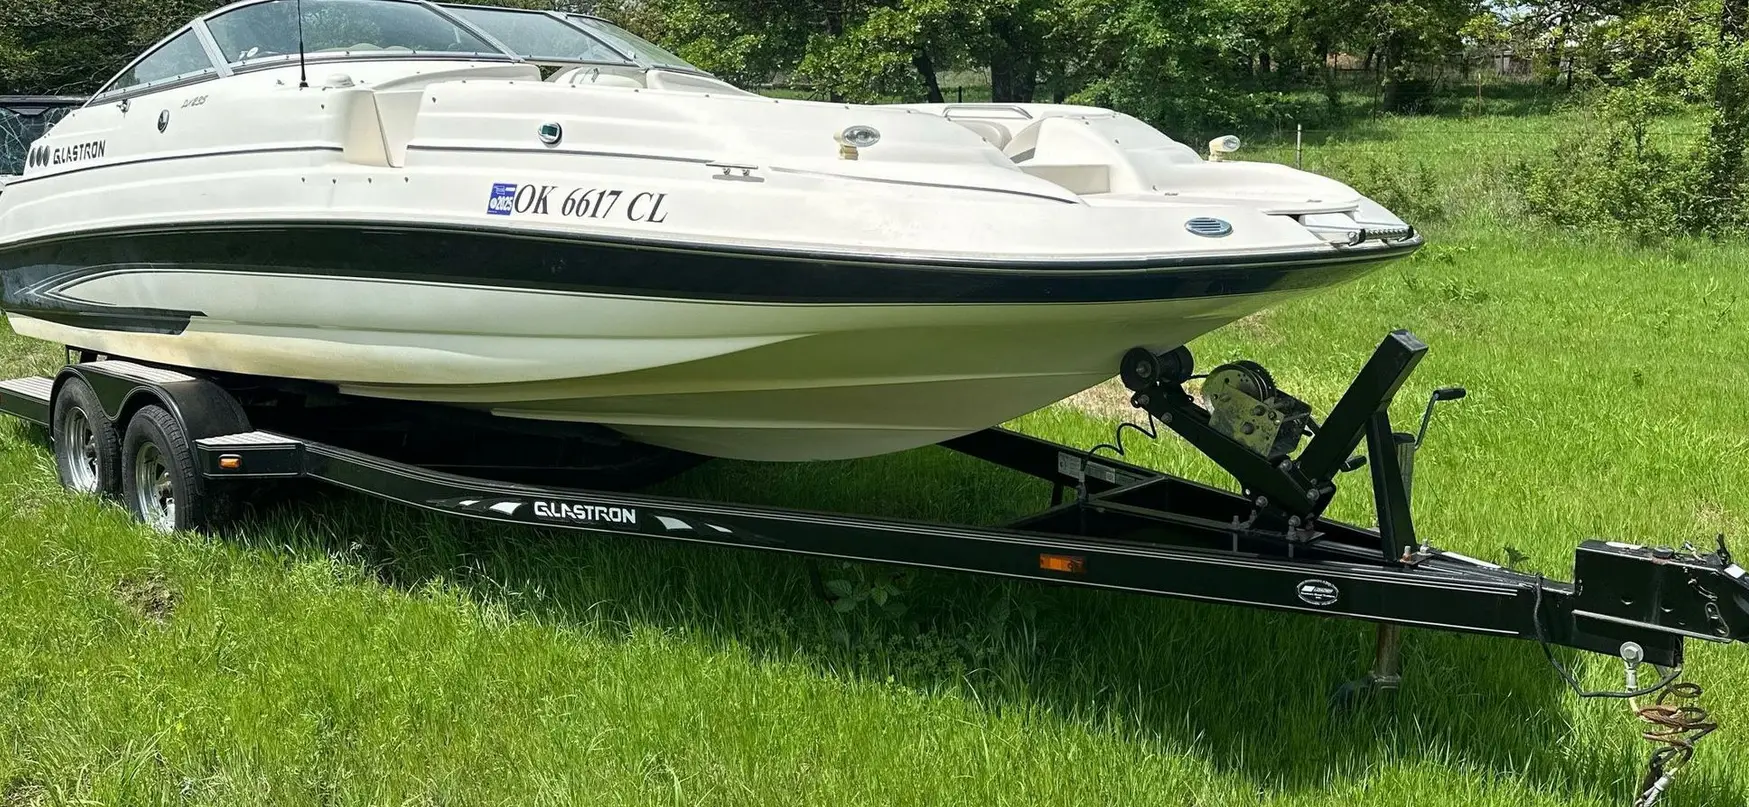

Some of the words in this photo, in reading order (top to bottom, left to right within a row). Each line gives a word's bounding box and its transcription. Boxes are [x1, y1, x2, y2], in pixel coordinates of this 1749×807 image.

[53, 140, 106, 165] GLASTRON
[495, 196, 513, 211] 2025
[514, 184, 558, 215] OK
[561, 187, 623, 219] 6617
[627, 191, 669, 223] CL
[534, 501, 636, 524] GLASTRON
